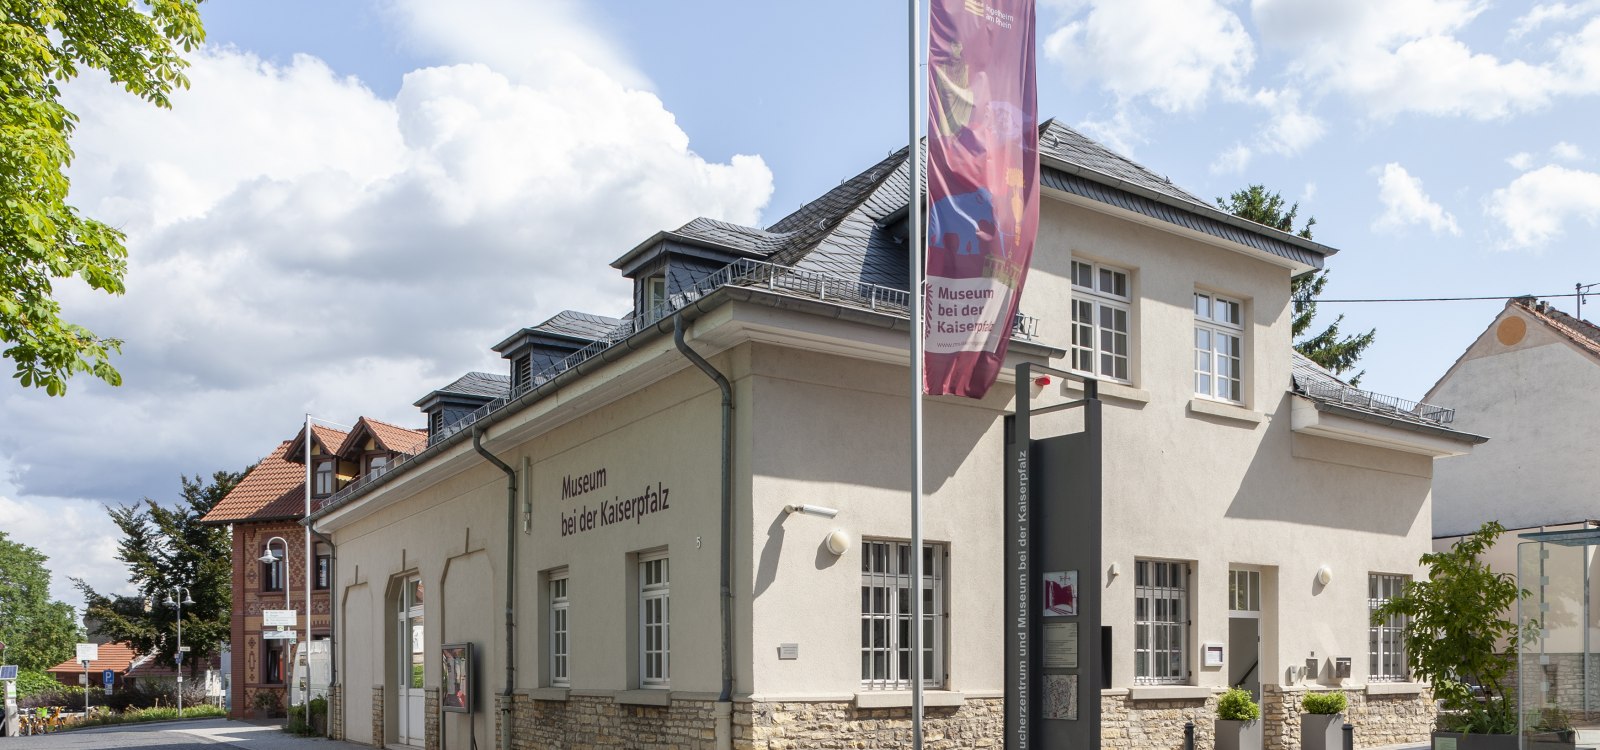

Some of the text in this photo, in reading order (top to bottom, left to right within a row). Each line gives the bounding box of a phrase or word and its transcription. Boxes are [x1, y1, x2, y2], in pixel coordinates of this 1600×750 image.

[995, 17, 1012, 29] Rhein
[938, 287, 994, 300] Museum
[938, 304, 984, 317] bei der
[561, 467, 607, 500] Museum
[561, 481, 670, 537] bei der Kaiserpfalz
[696, 536, 701, 549] 5
[1018, 450, 1028, 749] ucherzentrum und Museum bei der Kaiserpfalz
[105, 671, 112, 682] P
